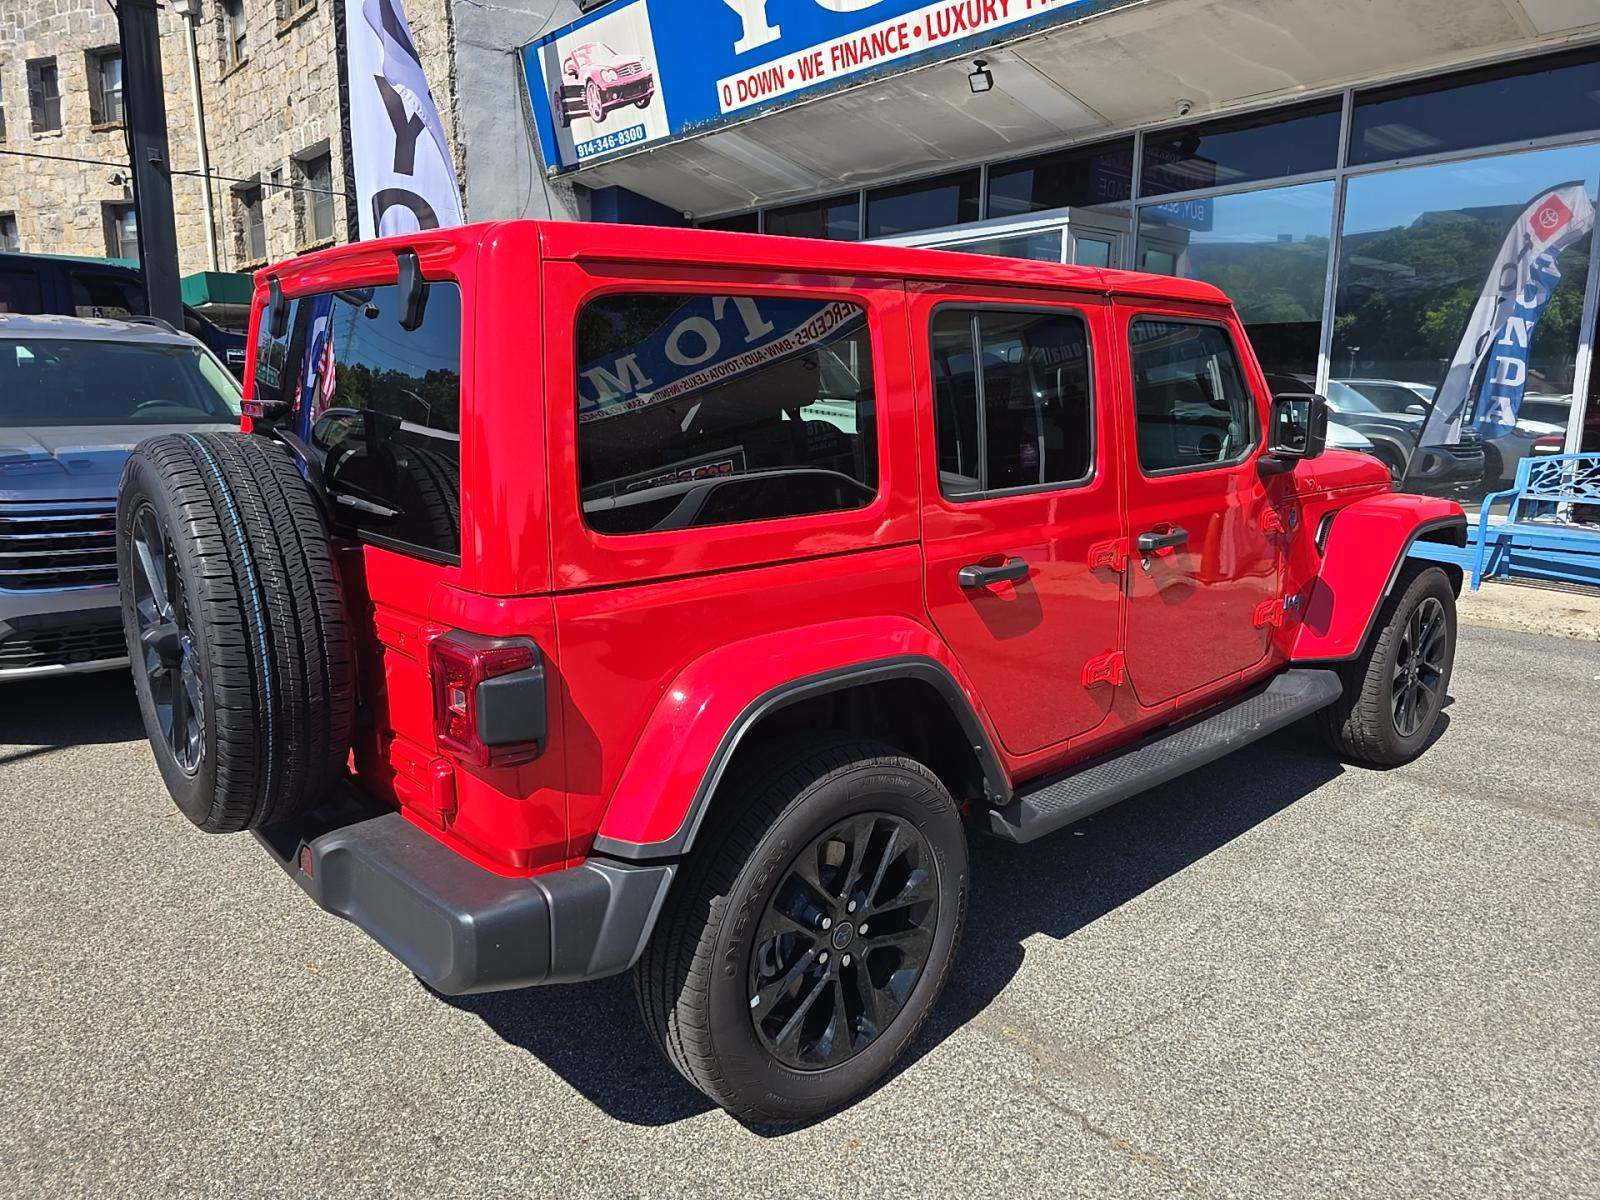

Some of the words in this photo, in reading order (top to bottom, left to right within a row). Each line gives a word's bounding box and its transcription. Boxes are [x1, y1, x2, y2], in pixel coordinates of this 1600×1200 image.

[723, 84, 732, 107] 0
[736, 65, 785, 102] DOWN
[797, 51, 825, 82] WE
[830, 22, 910, 72] FINANCE
[925, 0, 1013, 41] LUXURY
[577, 126, 643, 157] 914-346-8300
